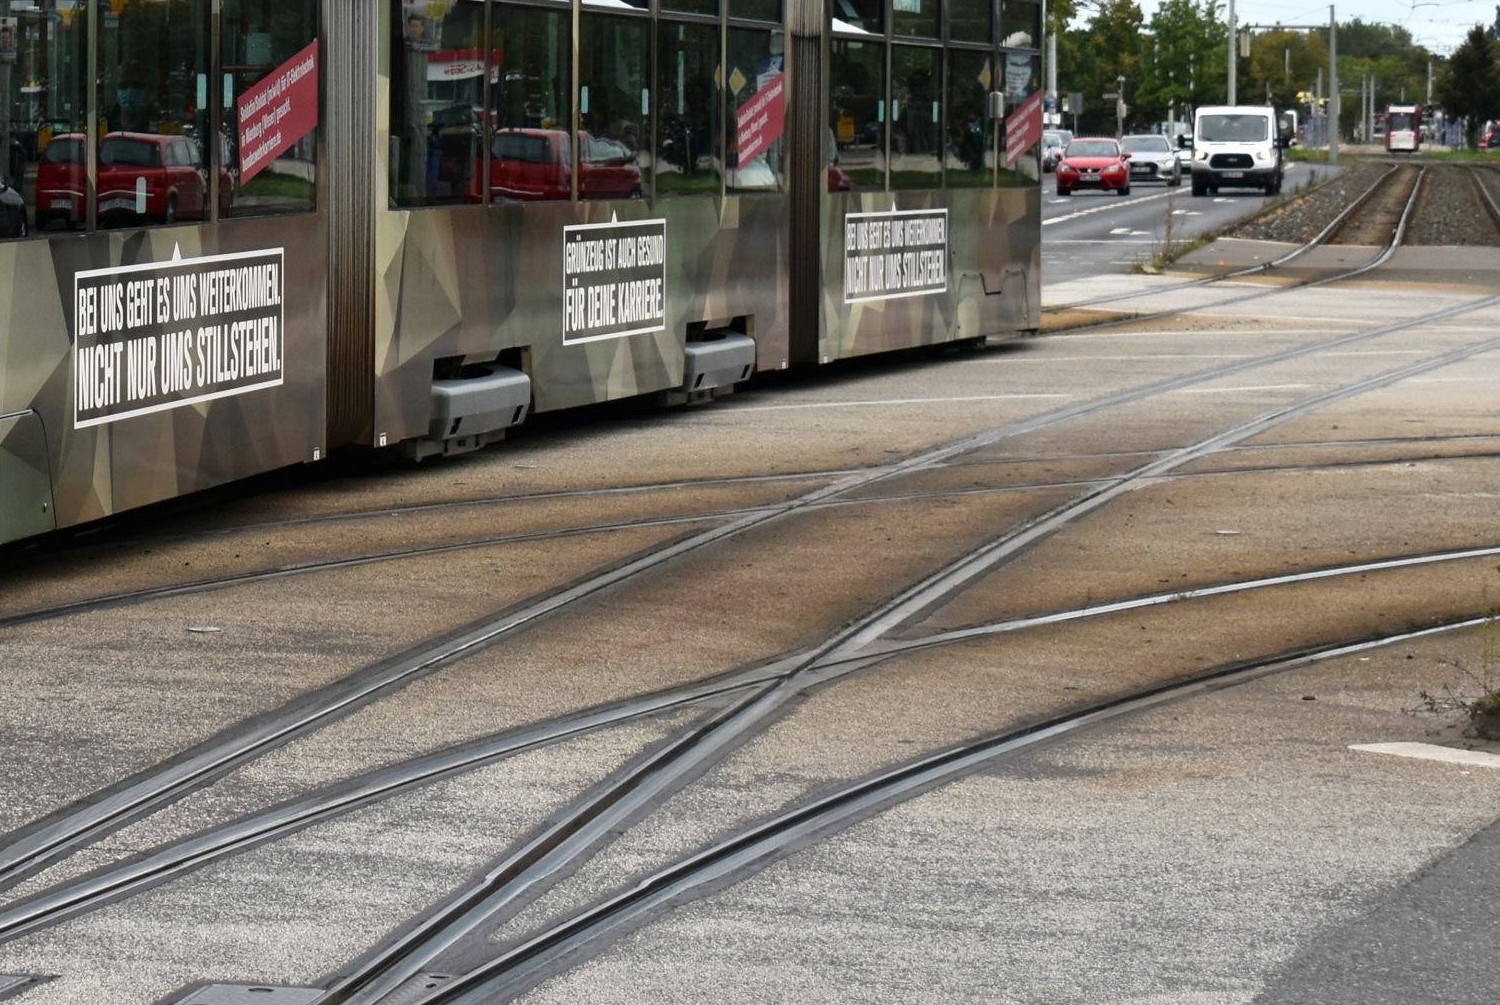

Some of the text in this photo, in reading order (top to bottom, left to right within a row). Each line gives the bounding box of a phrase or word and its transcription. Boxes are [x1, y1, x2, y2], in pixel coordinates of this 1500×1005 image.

[566, 235, 664, 274] GRÜNZEUG IST AUCH GESUND
[78, 263, 280, 335] BEI UNS GEHT ES UMS WEITERKOMMEN.
[566, 278, 663, 331] FÜR DEINE KARRIERE.
[79, 316, 280, 411] NICHT NUR UMS STILLSTEHEN.
